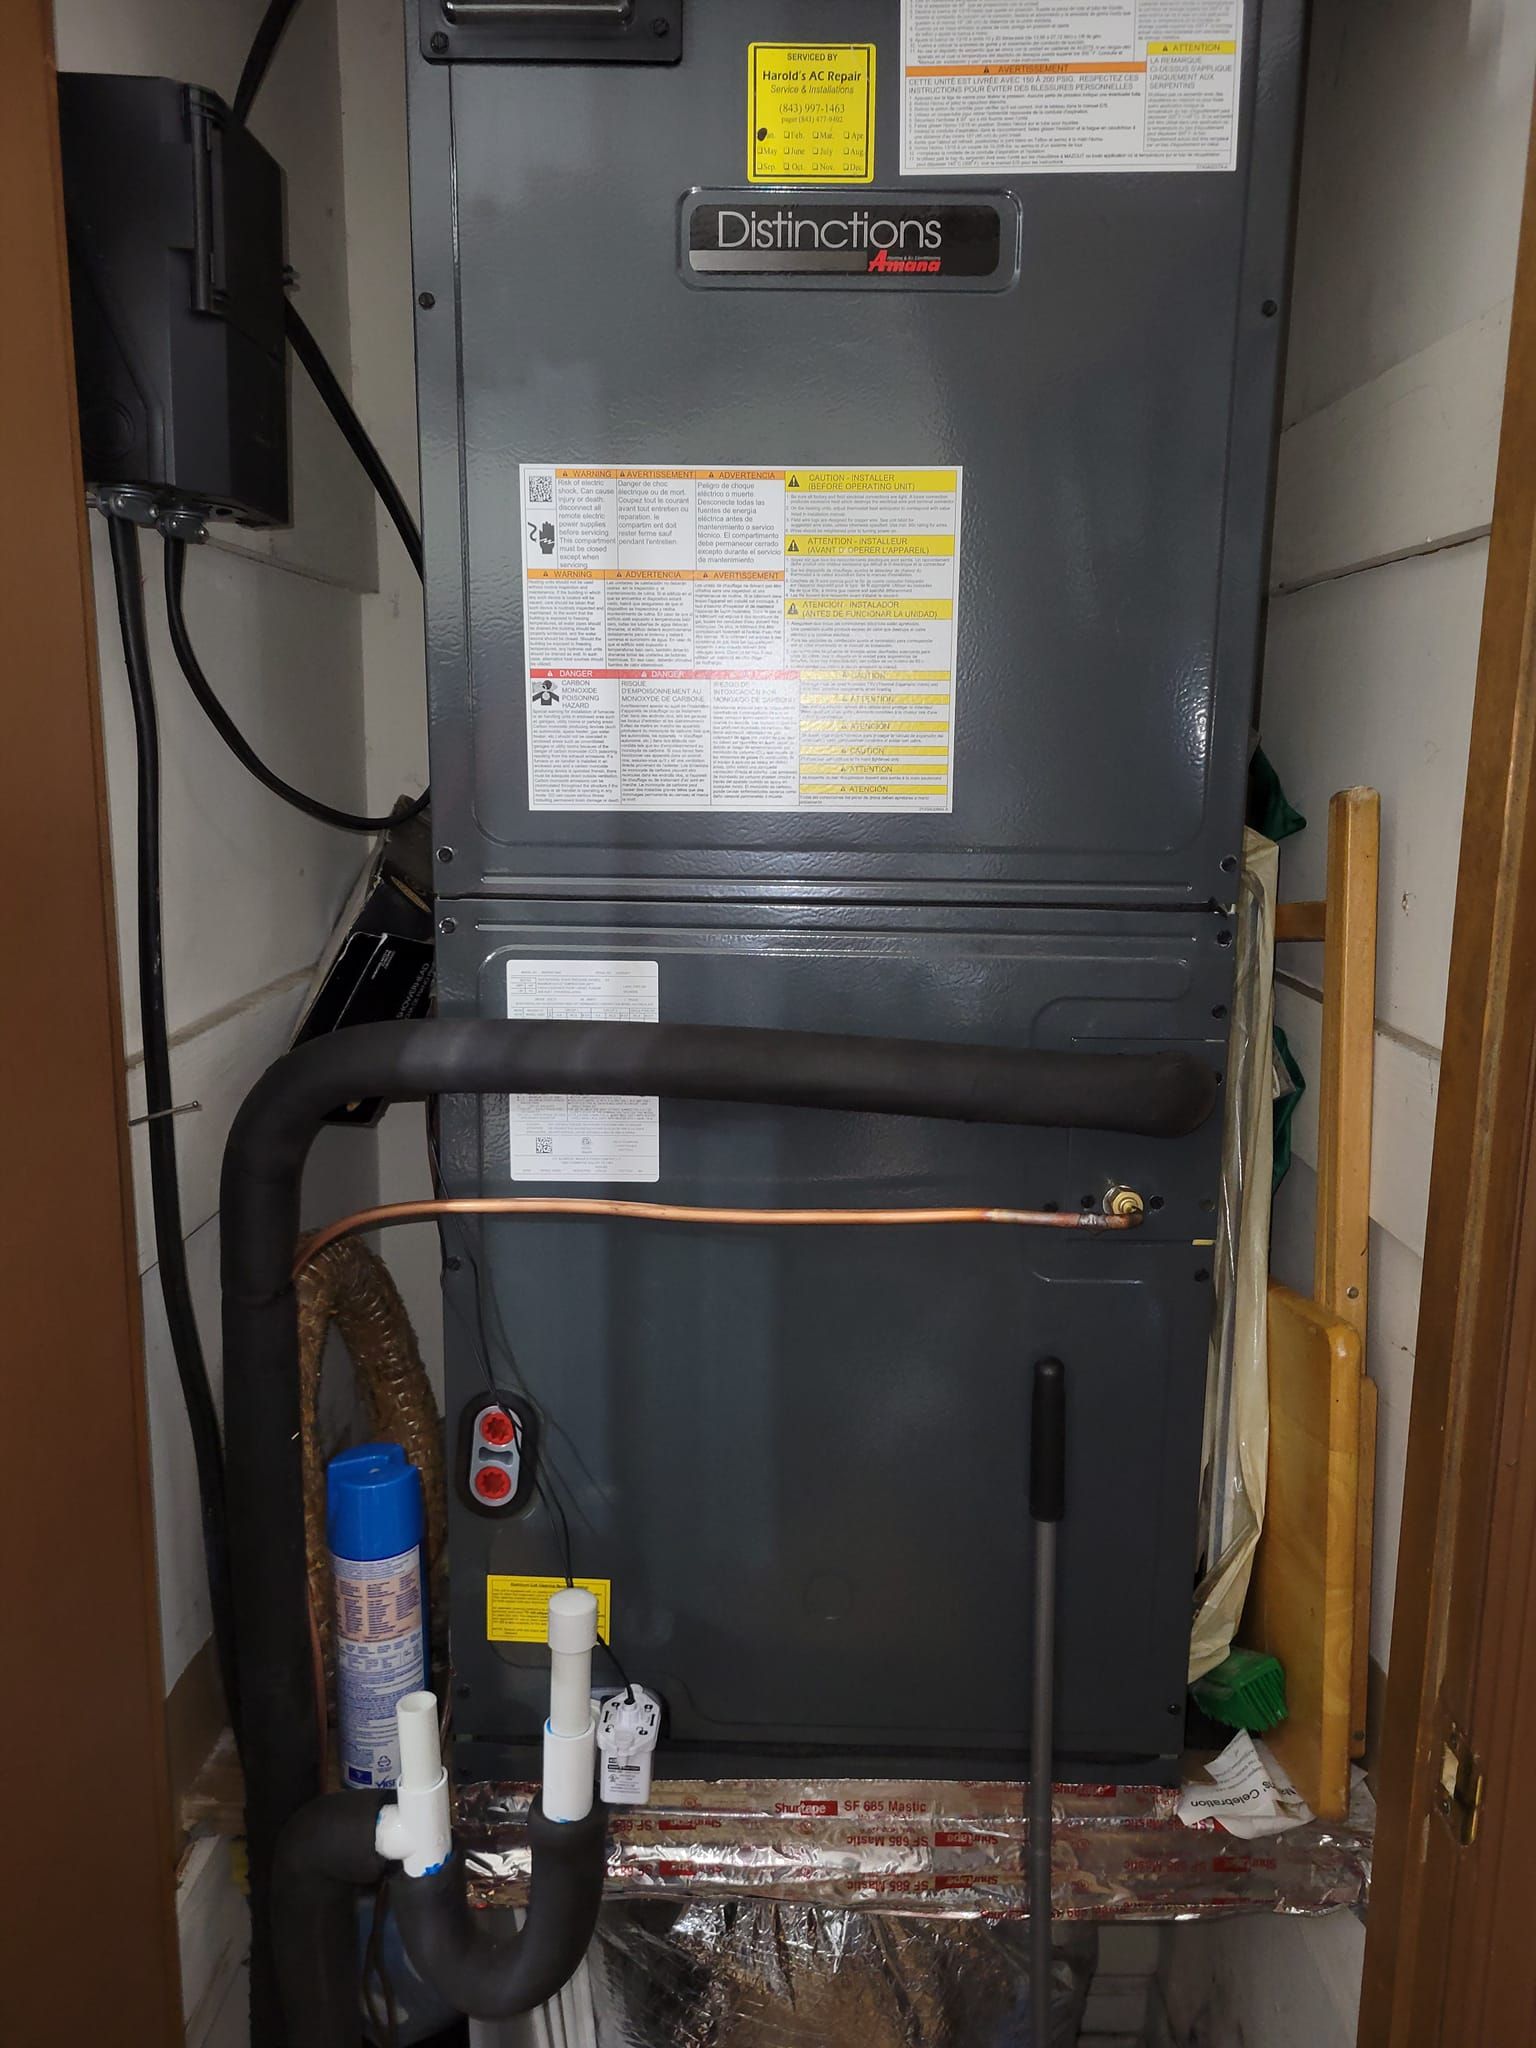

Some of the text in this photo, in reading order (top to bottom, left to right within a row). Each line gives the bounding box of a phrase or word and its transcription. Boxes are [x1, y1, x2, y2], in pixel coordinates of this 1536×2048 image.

[787, 53, 837, 61] SERVICED BY
[998, 64, 1068, 73] AVERTISSEMENT
[763, 71, 861, 83] Harold's AC Repair
[771, 85, 798, 93] Service
[809, 85, 854, 94] Installations
[909, 85, 962, 94] INSTRUCTIONS
[964, 85, 985, 93] POUR
[1030, 83, 1074, 91] BLESSURES
[779, 104, 845, 113] (843) 997-1463
[718, 211, 942, 249] Distinctions
[868, 250, 941, 272] Amana
[626, 571, 682, 579] ADVERTENCIA
[802, 610, 831, 618] (ANTES
[1191, 1789, 1260, 1808] Celebration
[844, 1801, 859, 1811] SF
[864, 1801, 883, 1811] 685
[888, 1801, 926, 1812] Mastic
[847, 1836, 884, 1846] Mastic
[890, 1837, 909, 1847] 685
[914, 1837, 928, 1846] SF
[847, 1880, 885, 1891] Mastic
[890, 1880, 909, 1891] 685
[914, 1882, 928, 1890] SF
